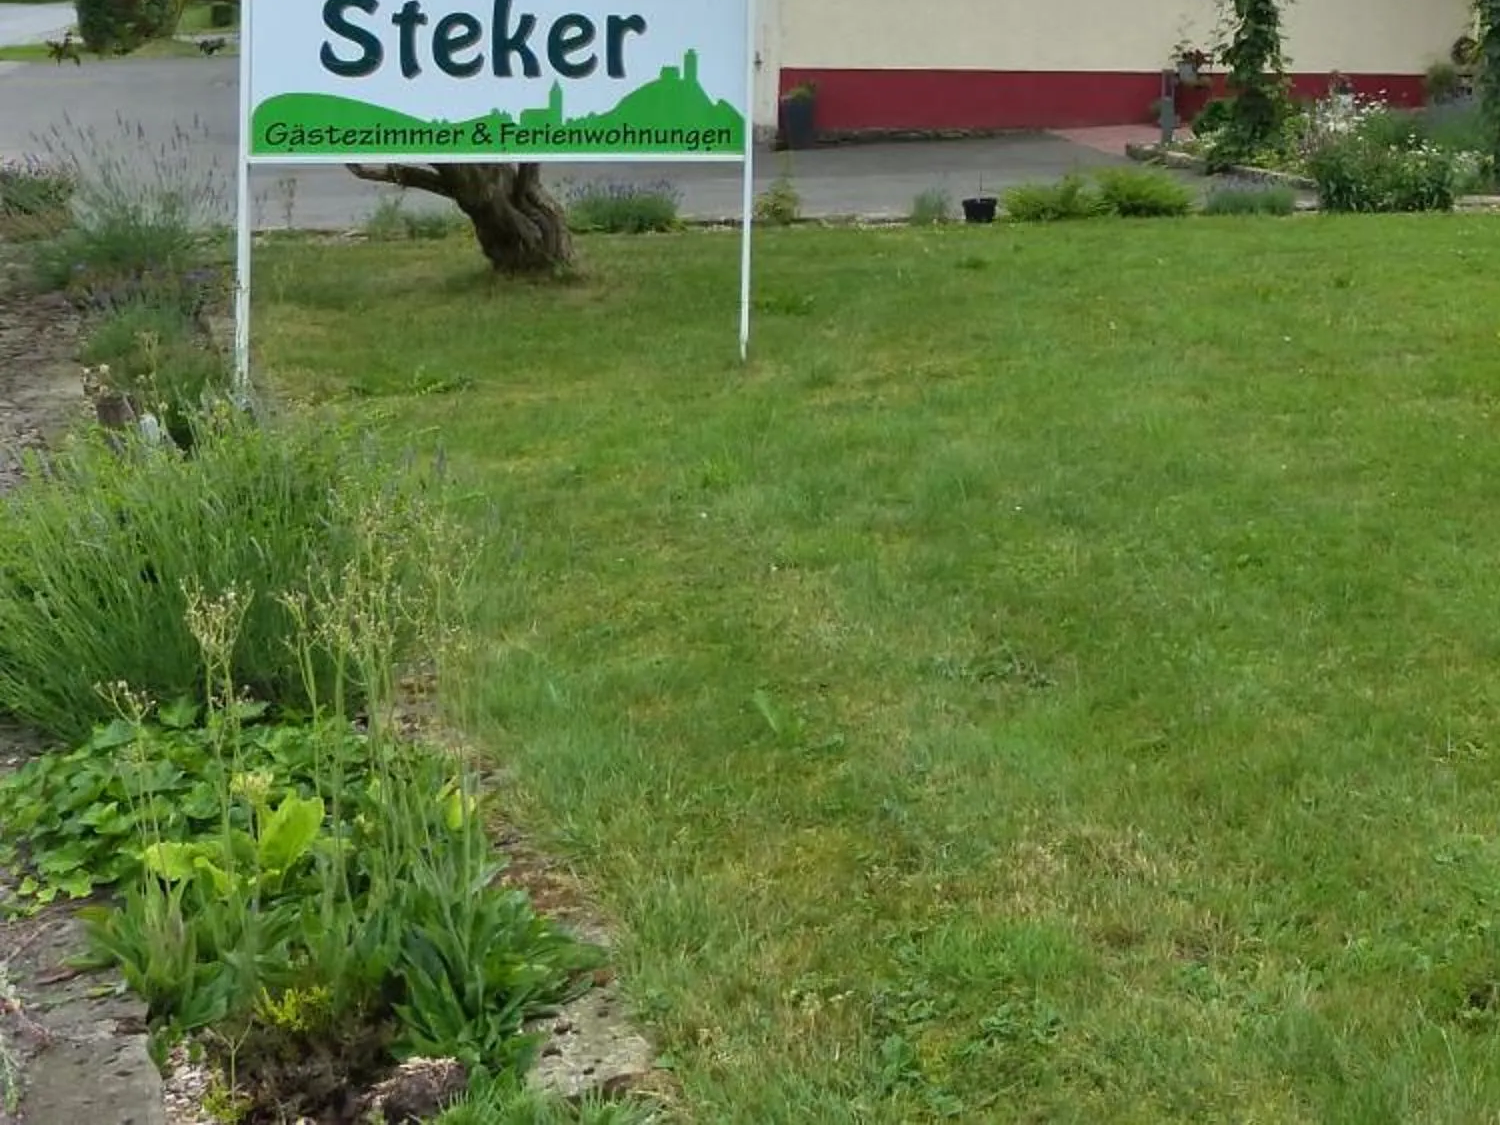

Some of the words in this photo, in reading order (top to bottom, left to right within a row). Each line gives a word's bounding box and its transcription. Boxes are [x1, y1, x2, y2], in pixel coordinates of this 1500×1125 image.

[265, 122, 464, 146] Gästezimmer
[471, 125, 493, 145] &
[500, 124, 731, 151] Ferienwohnungen
